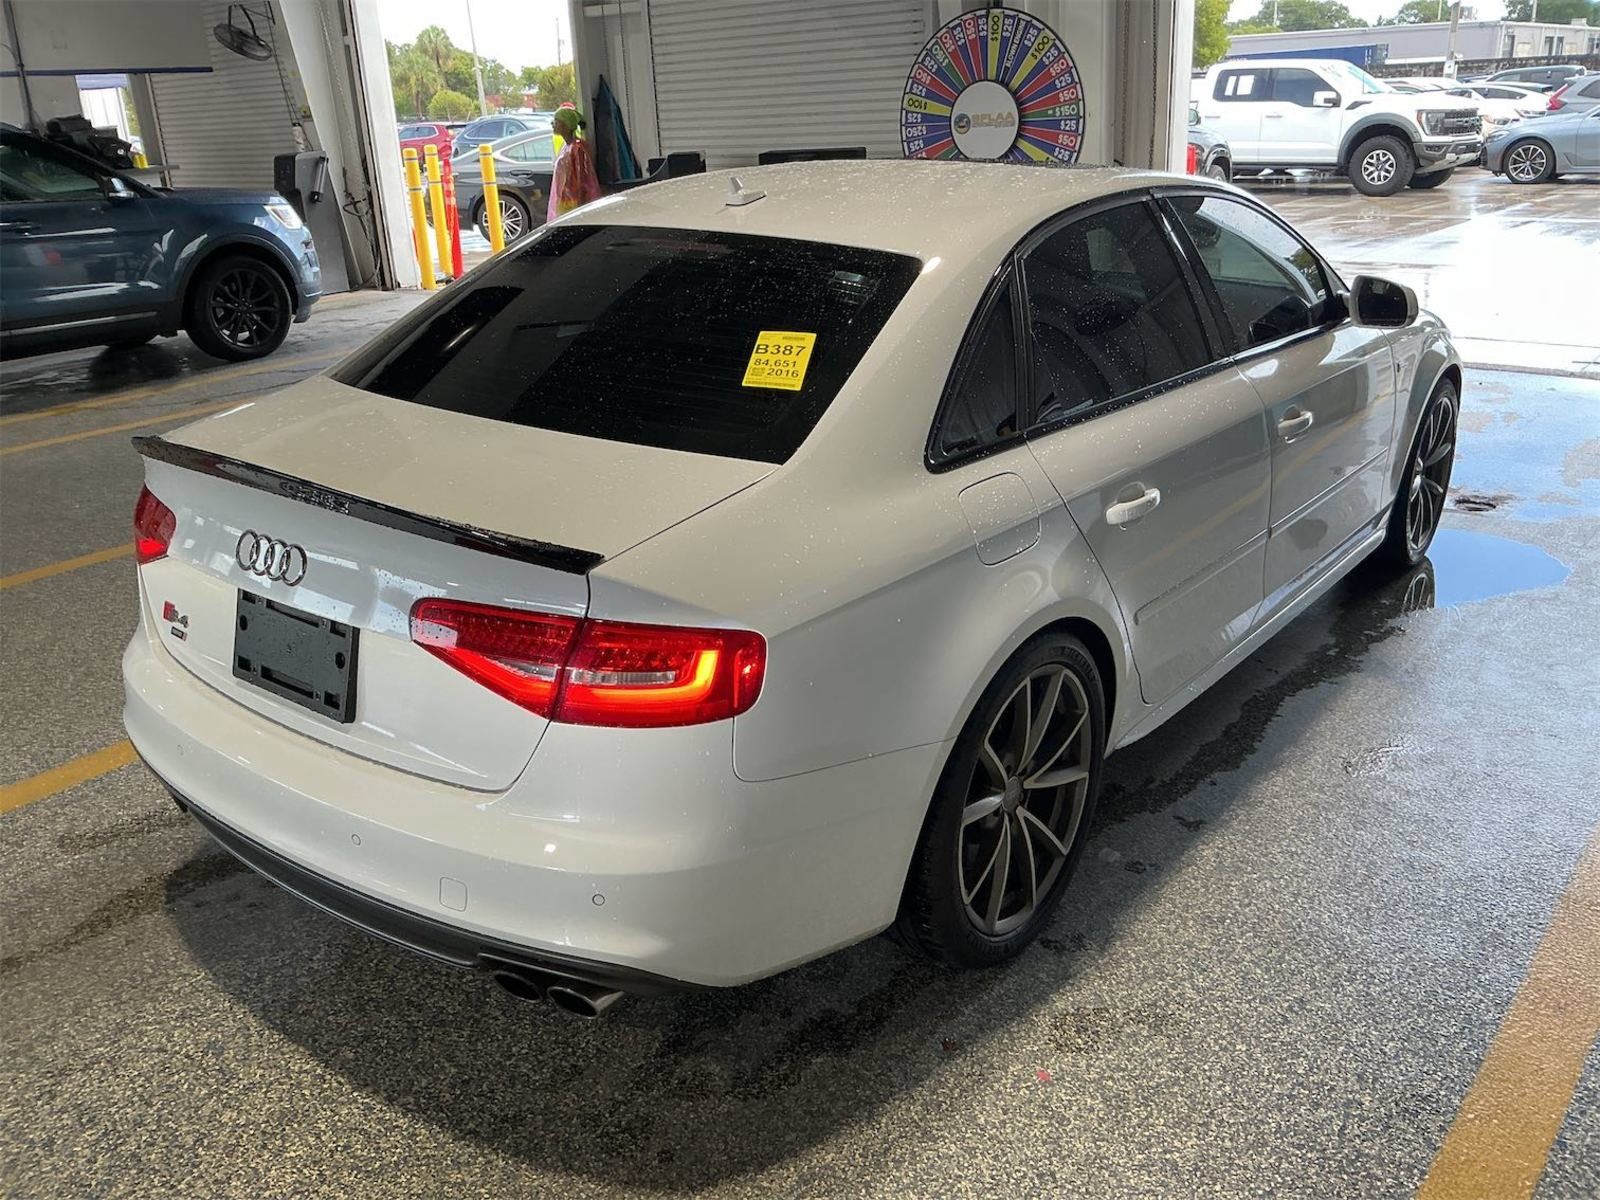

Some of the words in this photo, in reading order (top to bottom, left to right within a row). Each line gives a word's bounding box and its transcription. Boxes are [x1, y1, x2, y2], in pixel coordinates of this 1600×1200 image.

[966, 20, 976, 40] $50
[978, 18, 988, 36] $25
[991, 16, 1000, 42] $100
[1002, 18, 1013, 38] $25
[1024, 28, 1038, 46] $25
[1031, 36, 1050, 60] $100
[1042, 46, 1058, 65] $25
[1050, 59, 1067, 76] $50
[1054, 74, 1072, 88] $25
[1058, 88, 1076, 102] $50
[908, 98, 928, 110] $100
[1056, 104, 1077, 116] $150
[908, 113, 922, 122] $25
[1060, 120, 1076, 130] $25
[1058, 134, 1076, 146] $50
[1054, 148, 1070, 160] $25
[754, 344, 806, 356] B387
[754, 358, 797, 368] 84,651
[767, 368, 800, 378] 2016
